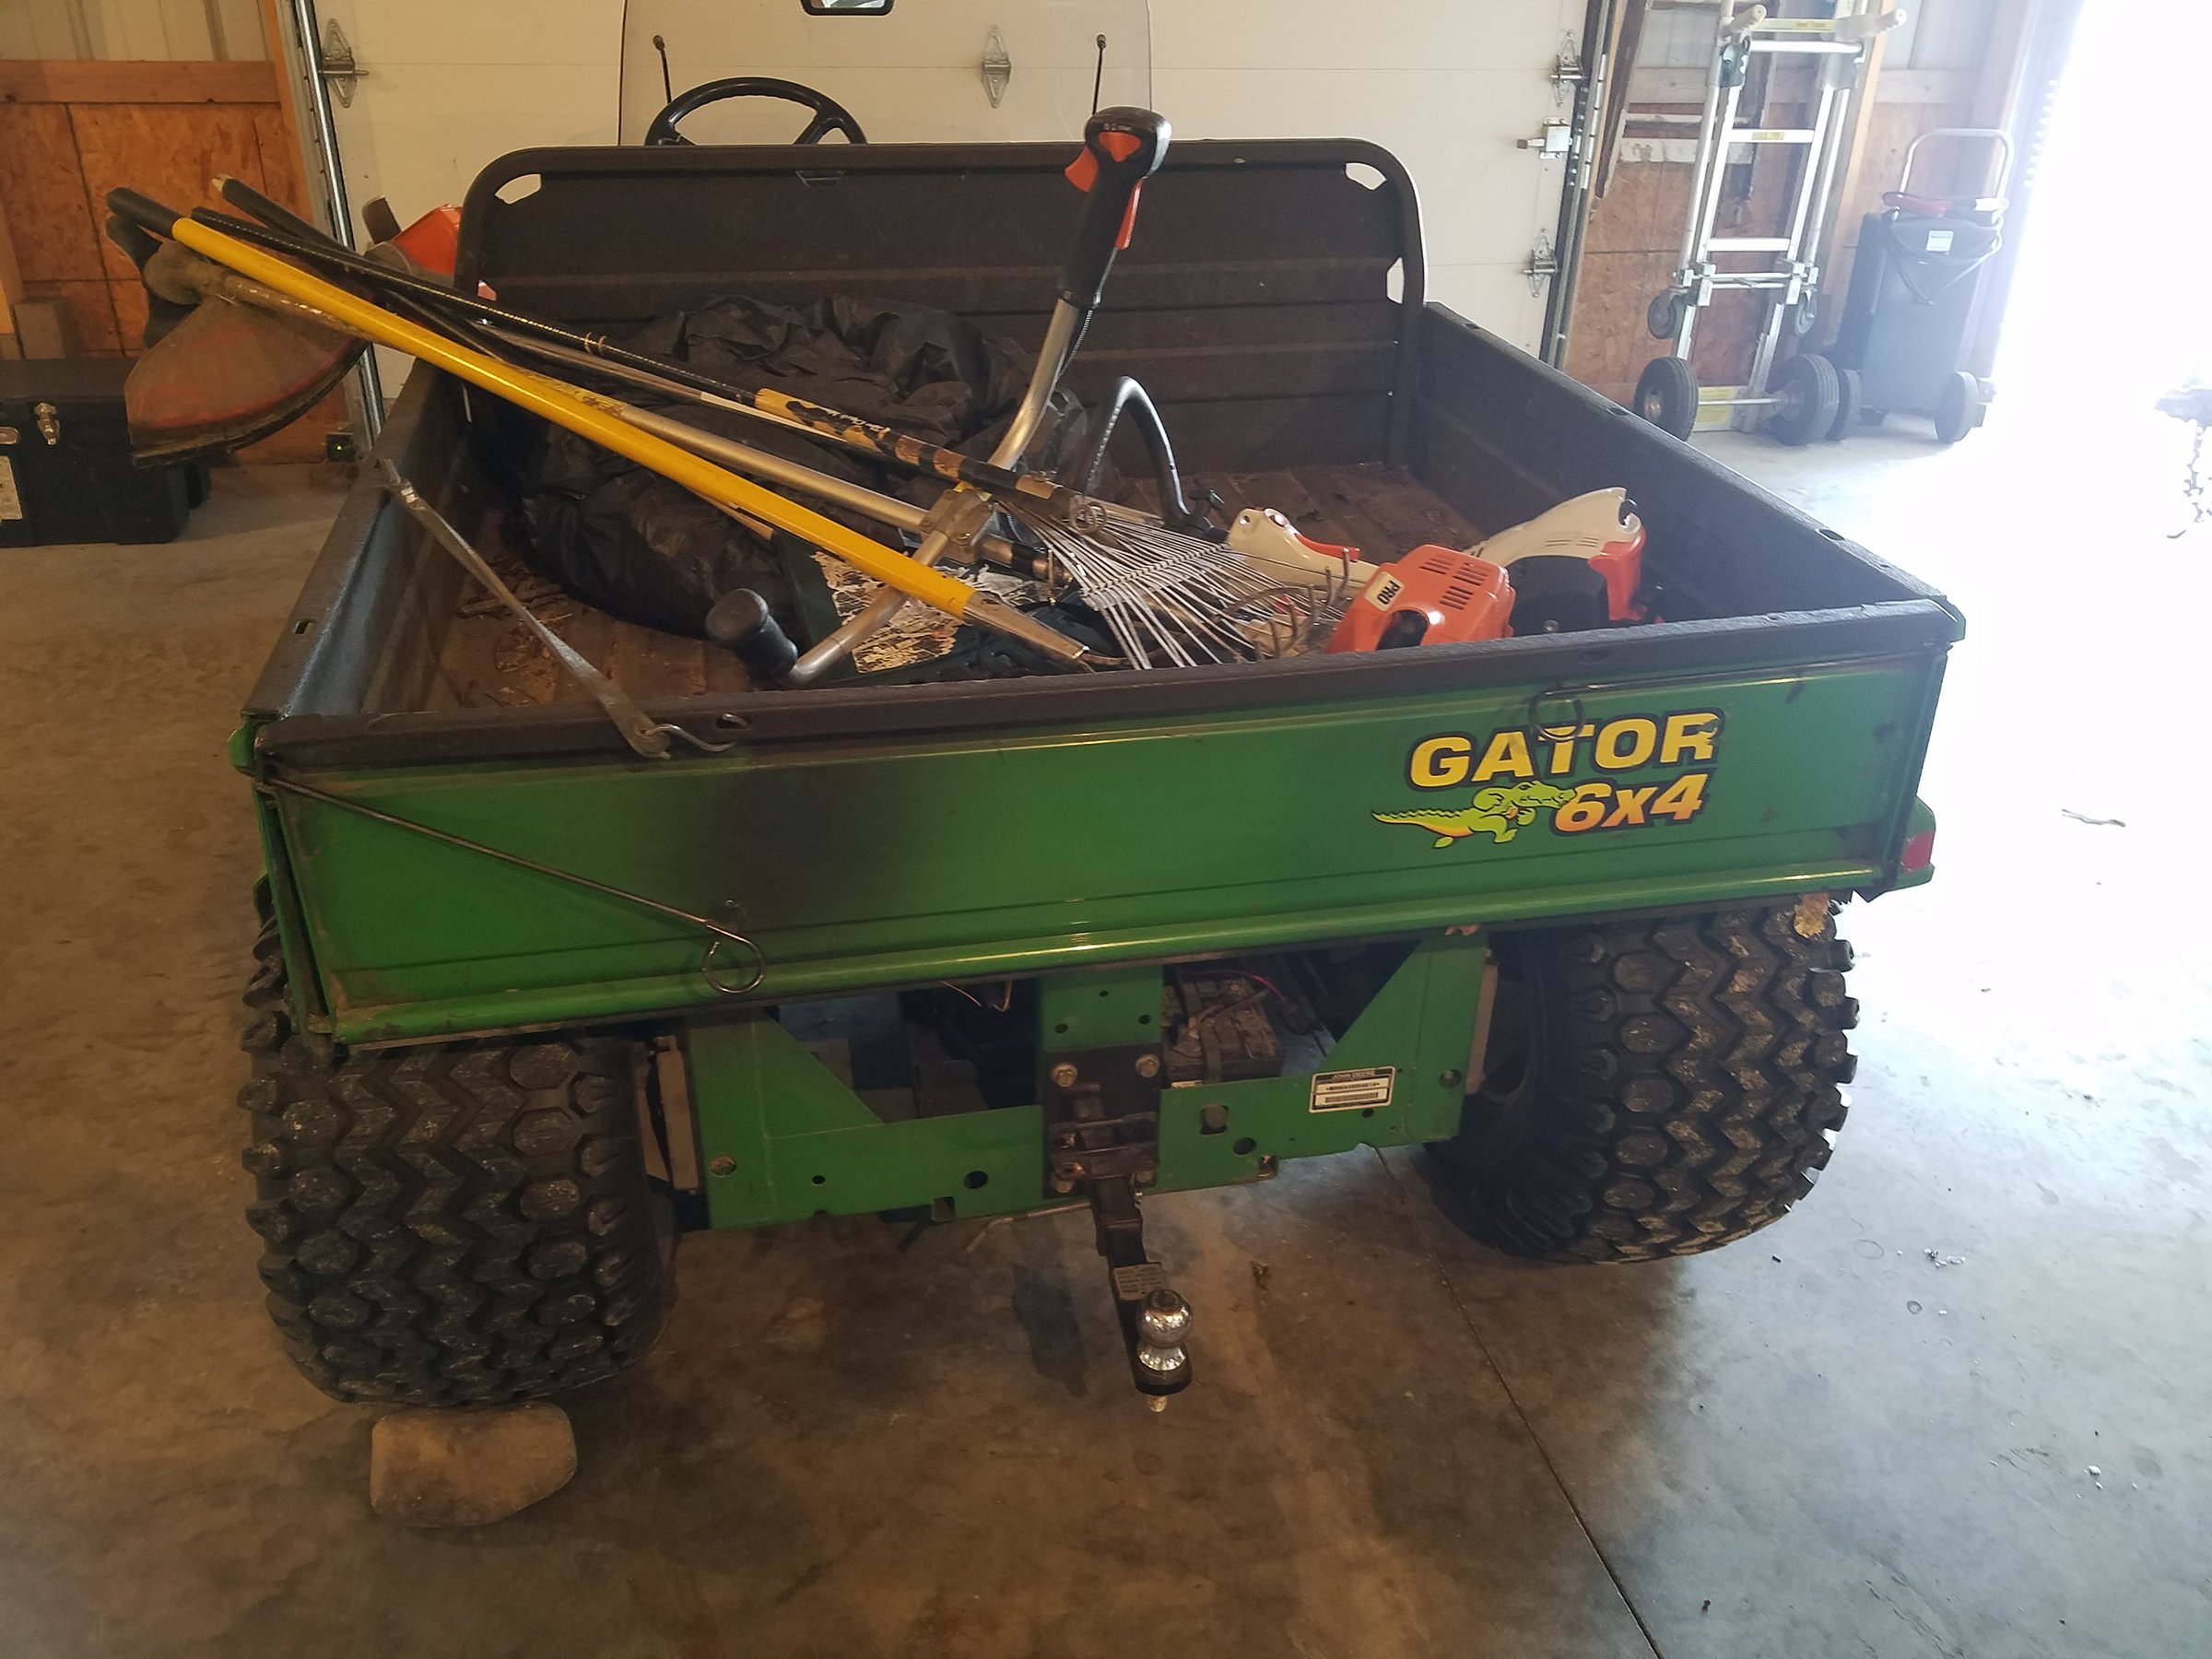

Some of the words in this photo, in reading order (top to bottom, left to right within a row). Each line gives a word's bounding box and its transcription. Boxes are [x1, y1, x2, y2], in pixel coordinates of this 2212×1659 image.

[1376, 580, 1401, 606] PRO
[1408, 711, 1722, 789] GATOR
[1554, 772, 1711, 832] 6x4
